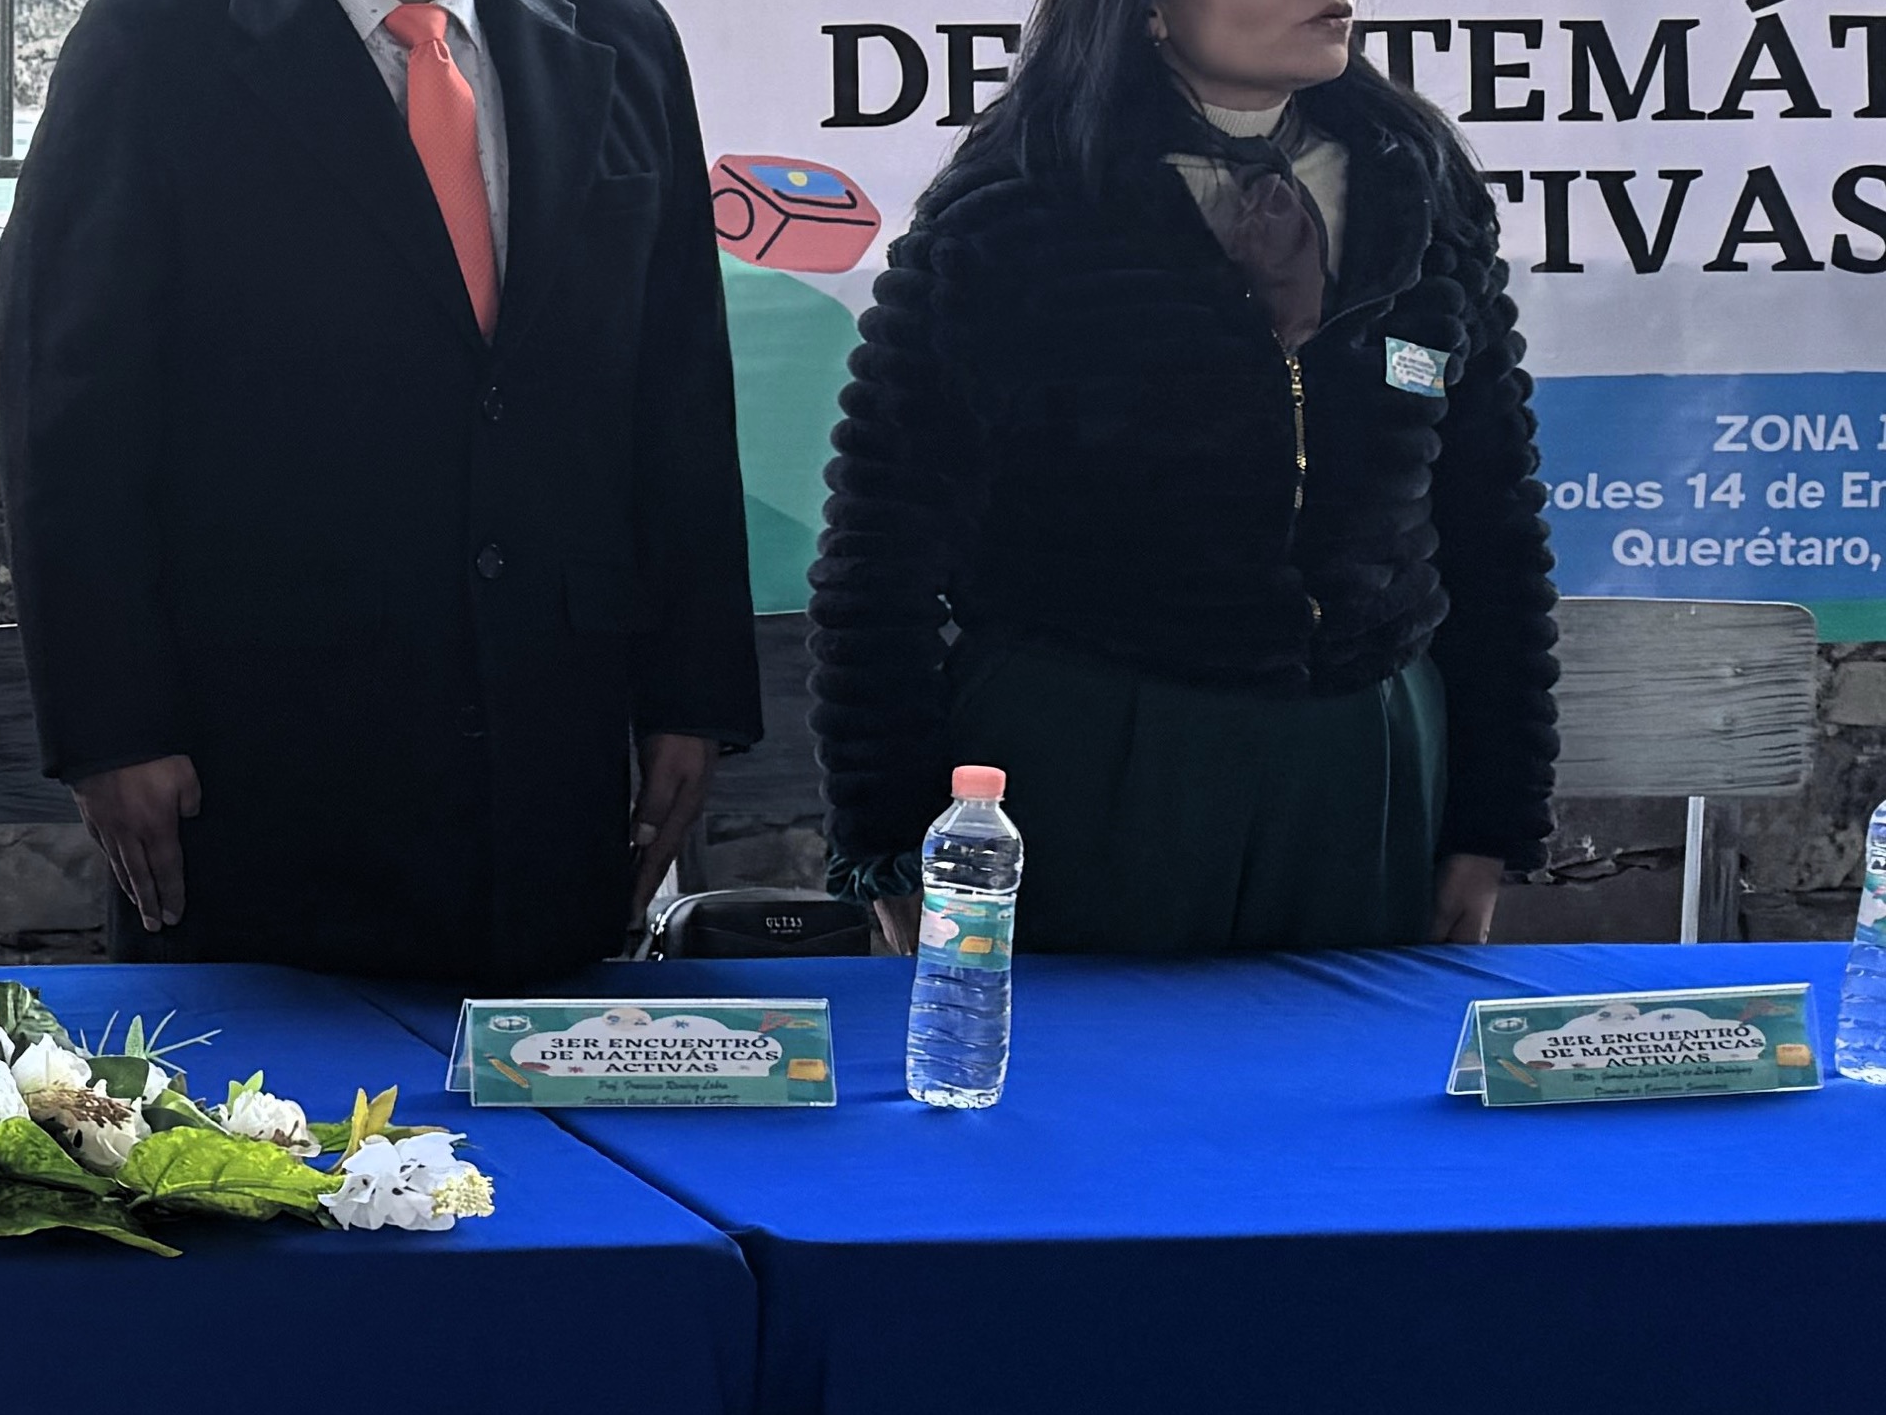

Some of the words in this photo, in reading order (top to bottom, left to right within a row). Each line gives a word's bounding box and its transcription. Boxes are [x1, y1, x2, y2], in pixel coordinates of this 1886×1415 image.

[820, 23, 1022, 128] DE
[1712, 413, 1860, 453] ZONA
[1686, 472, 1747, 510] 14
[1765, 472, 1826, 510] de
[1611, 526, 1882, 572] Querétaro,
[550, 1037, 600, 1048] 3ER
[608, 1037, 769, 1049] ENCUENTRO
[1600, 1026, 1751, 1044] ENCUENTRO
[540, 1050, 574, 1061] DE
[582, 1048, 779, 1061] MATEMÁTICAS
[1540, 1048, 1574, 1059] DE
[1580, 1037, 1765, 1058] MATEMÁTICAS
[604, 1063, 719, 1073] ACTIVAS
[1605, 1052, 1711, 1067] ACTIVAS
